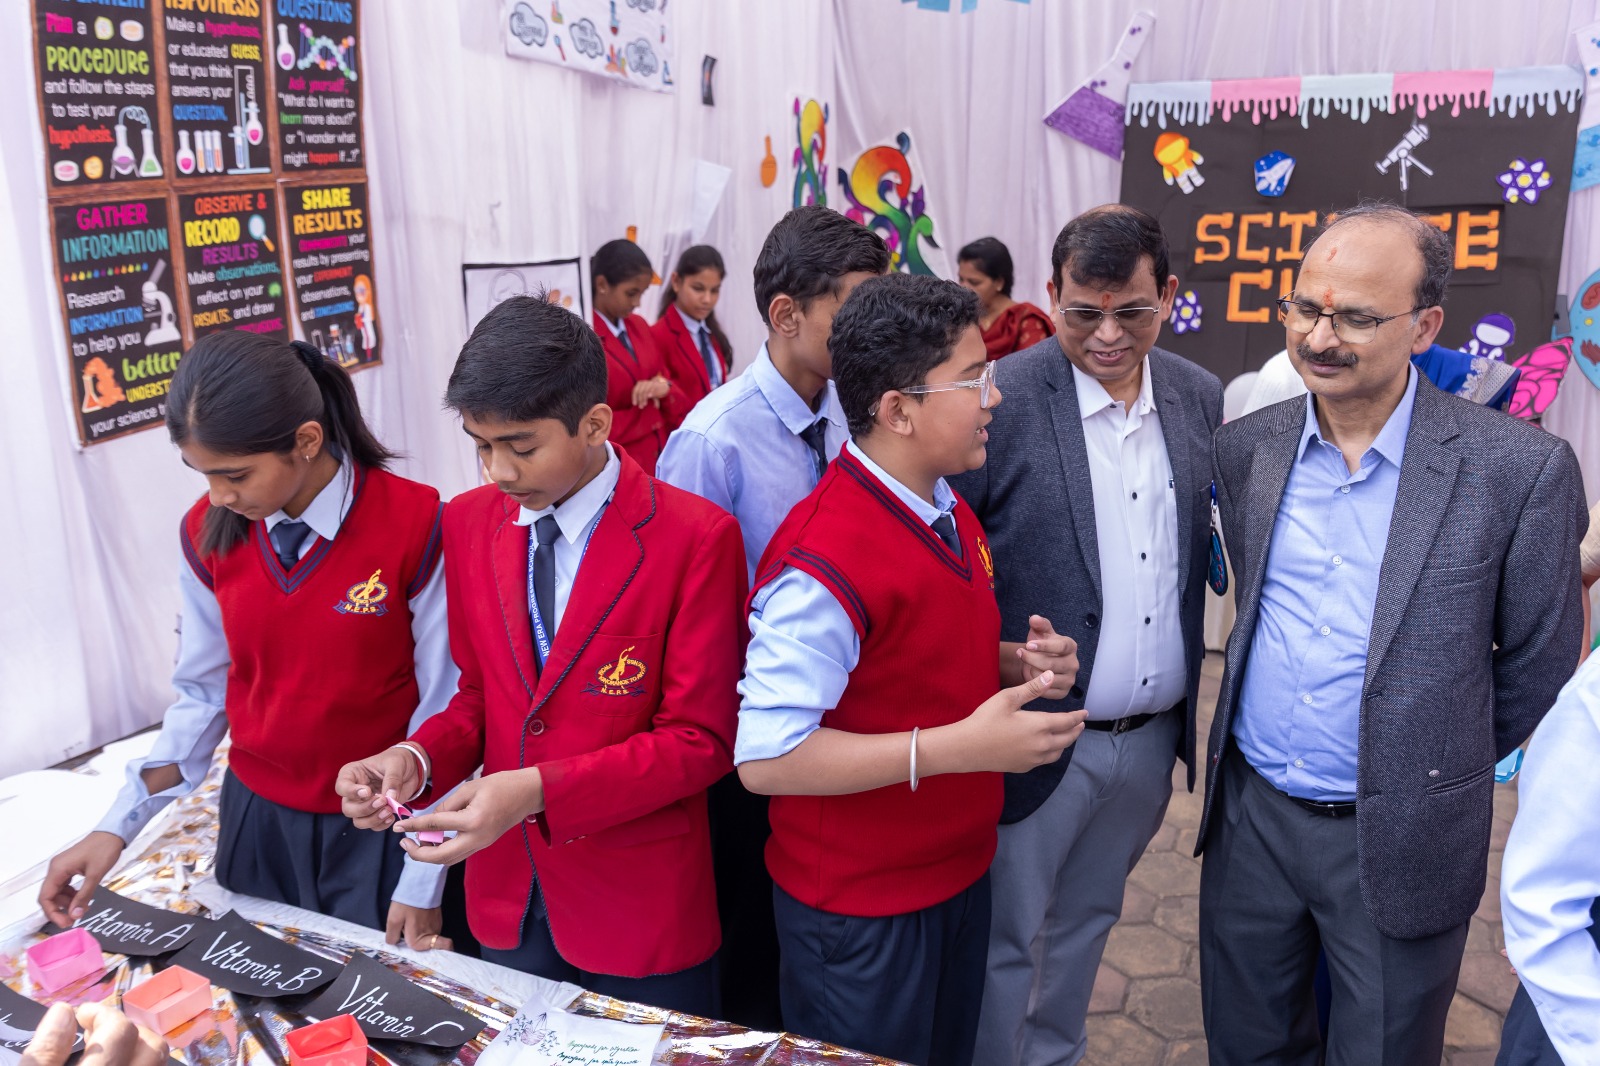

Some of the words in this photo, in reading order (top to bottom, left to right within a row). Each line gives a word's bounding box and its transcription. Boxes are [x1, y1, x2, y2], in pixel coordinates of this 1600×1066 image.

[77, 20, 87, 35] a
[166, 16, 196, 32] Make
[197, 22, 205, 33] a
[168, 43, 180, 56] or
[181, 42, 228, 58] educated
[169, 61, 189, 76] that
[190, 66, 208, 80] you
[209, 63, 233, 78] think
[44, 78, 67, 94] and
[68, 78, 102, 94] follow
[104, 79, 123, 94] the
[125, 81, 155, 98] steps
[171, 85, 211, 97] answers
[211, 87, 233, 100] your
[288, 76, 306, 90] Ask
[52, 102, 66, 118] to
[67, 103, 90, 117] test
[91, 105, 117, 120] your
[306, 94, 318, 108] do
[319, 95, 324, 108] I
[324, 97, 345, 108] want
[345, 97, 356, 108] to
[303, 115, 325, 125] more
[285, 134, 296, 144] or
[306, 131, 336, 144] wonder
[337, 131, 356, 144] what
[284, 152, 308, 167] might
[194, 194, 253, 216] OBSERVE
[256, 192, 267, 210] &
[302, 187, 351, 210] SHARE
[76, 203, 148, 230] GATHER
[293, 208, 363, 235] RESULTS
[184, 217, 240, 247] RECORD
[348, 233, 366, 246] your
[1195, 209, 1499, 271] SCIE
[62, 228, 169, 263] INFORMATION
[202, 242, 258, 265] RESULTS
[293, 254, 319, 268] results
[319, 253, 329, 267] by
[331, 249, 369, 266] presenting
[187, 270, 215, 286] Make
[295, 274, 313, 288] your
[66, 285, 125, 309] Research
[197, 290, 229, 306] reflect
[229, 288, 243, 300] on
[243, 285, 264, 300] your
[69, 306, 144, 336] INFORMATION
[233, 304, 251, 320] and
[252, 302, 275, 316] draw
[72, 342, 88, 356] to
[89, 335, 117, 353] help
[117, 332, 141, 350] you
[122, 351, 181, 381] better
[126, 378, 173, 403] UNDERST
[90, 418, 116, 438] your
[117, 406, 158, 427] science
[158, 403, 167, 416] t
[536, 623, 545, 639] ERA
[540, 640, 550, 657] NEW
[72, 899, 154, 943] Vitamin
[148, 923, 195, 948] A
[201, 931, 282, 986] Vitamin
[276, 967, 322, 991] B
[337, 974, 415, 1038] Vitamin
